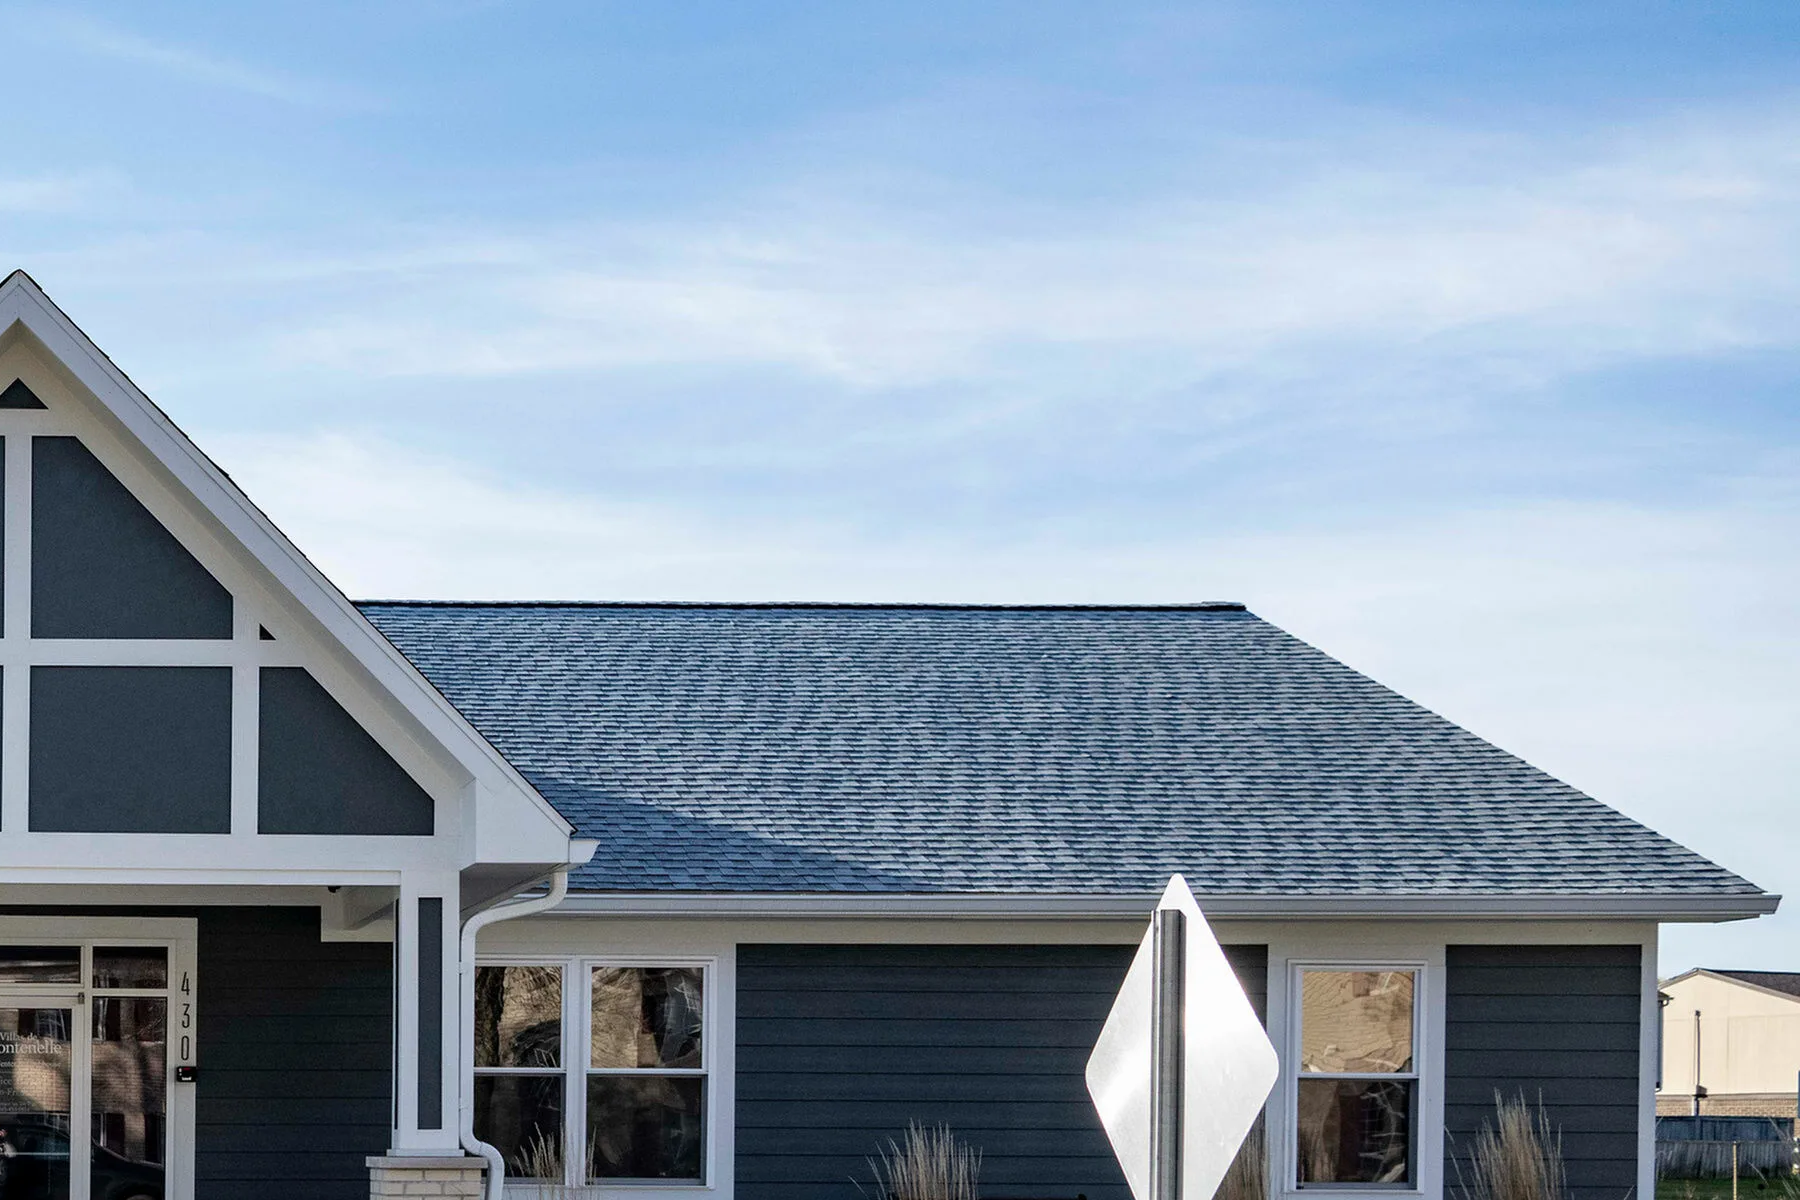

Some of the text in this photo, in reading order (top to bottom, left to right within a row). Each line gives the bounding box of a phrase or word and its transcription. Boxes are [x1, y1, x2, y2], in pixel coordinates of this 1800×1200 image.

[0, 1031, 38, 1041] Villas de
[180, 971, 191, 1061] 430
